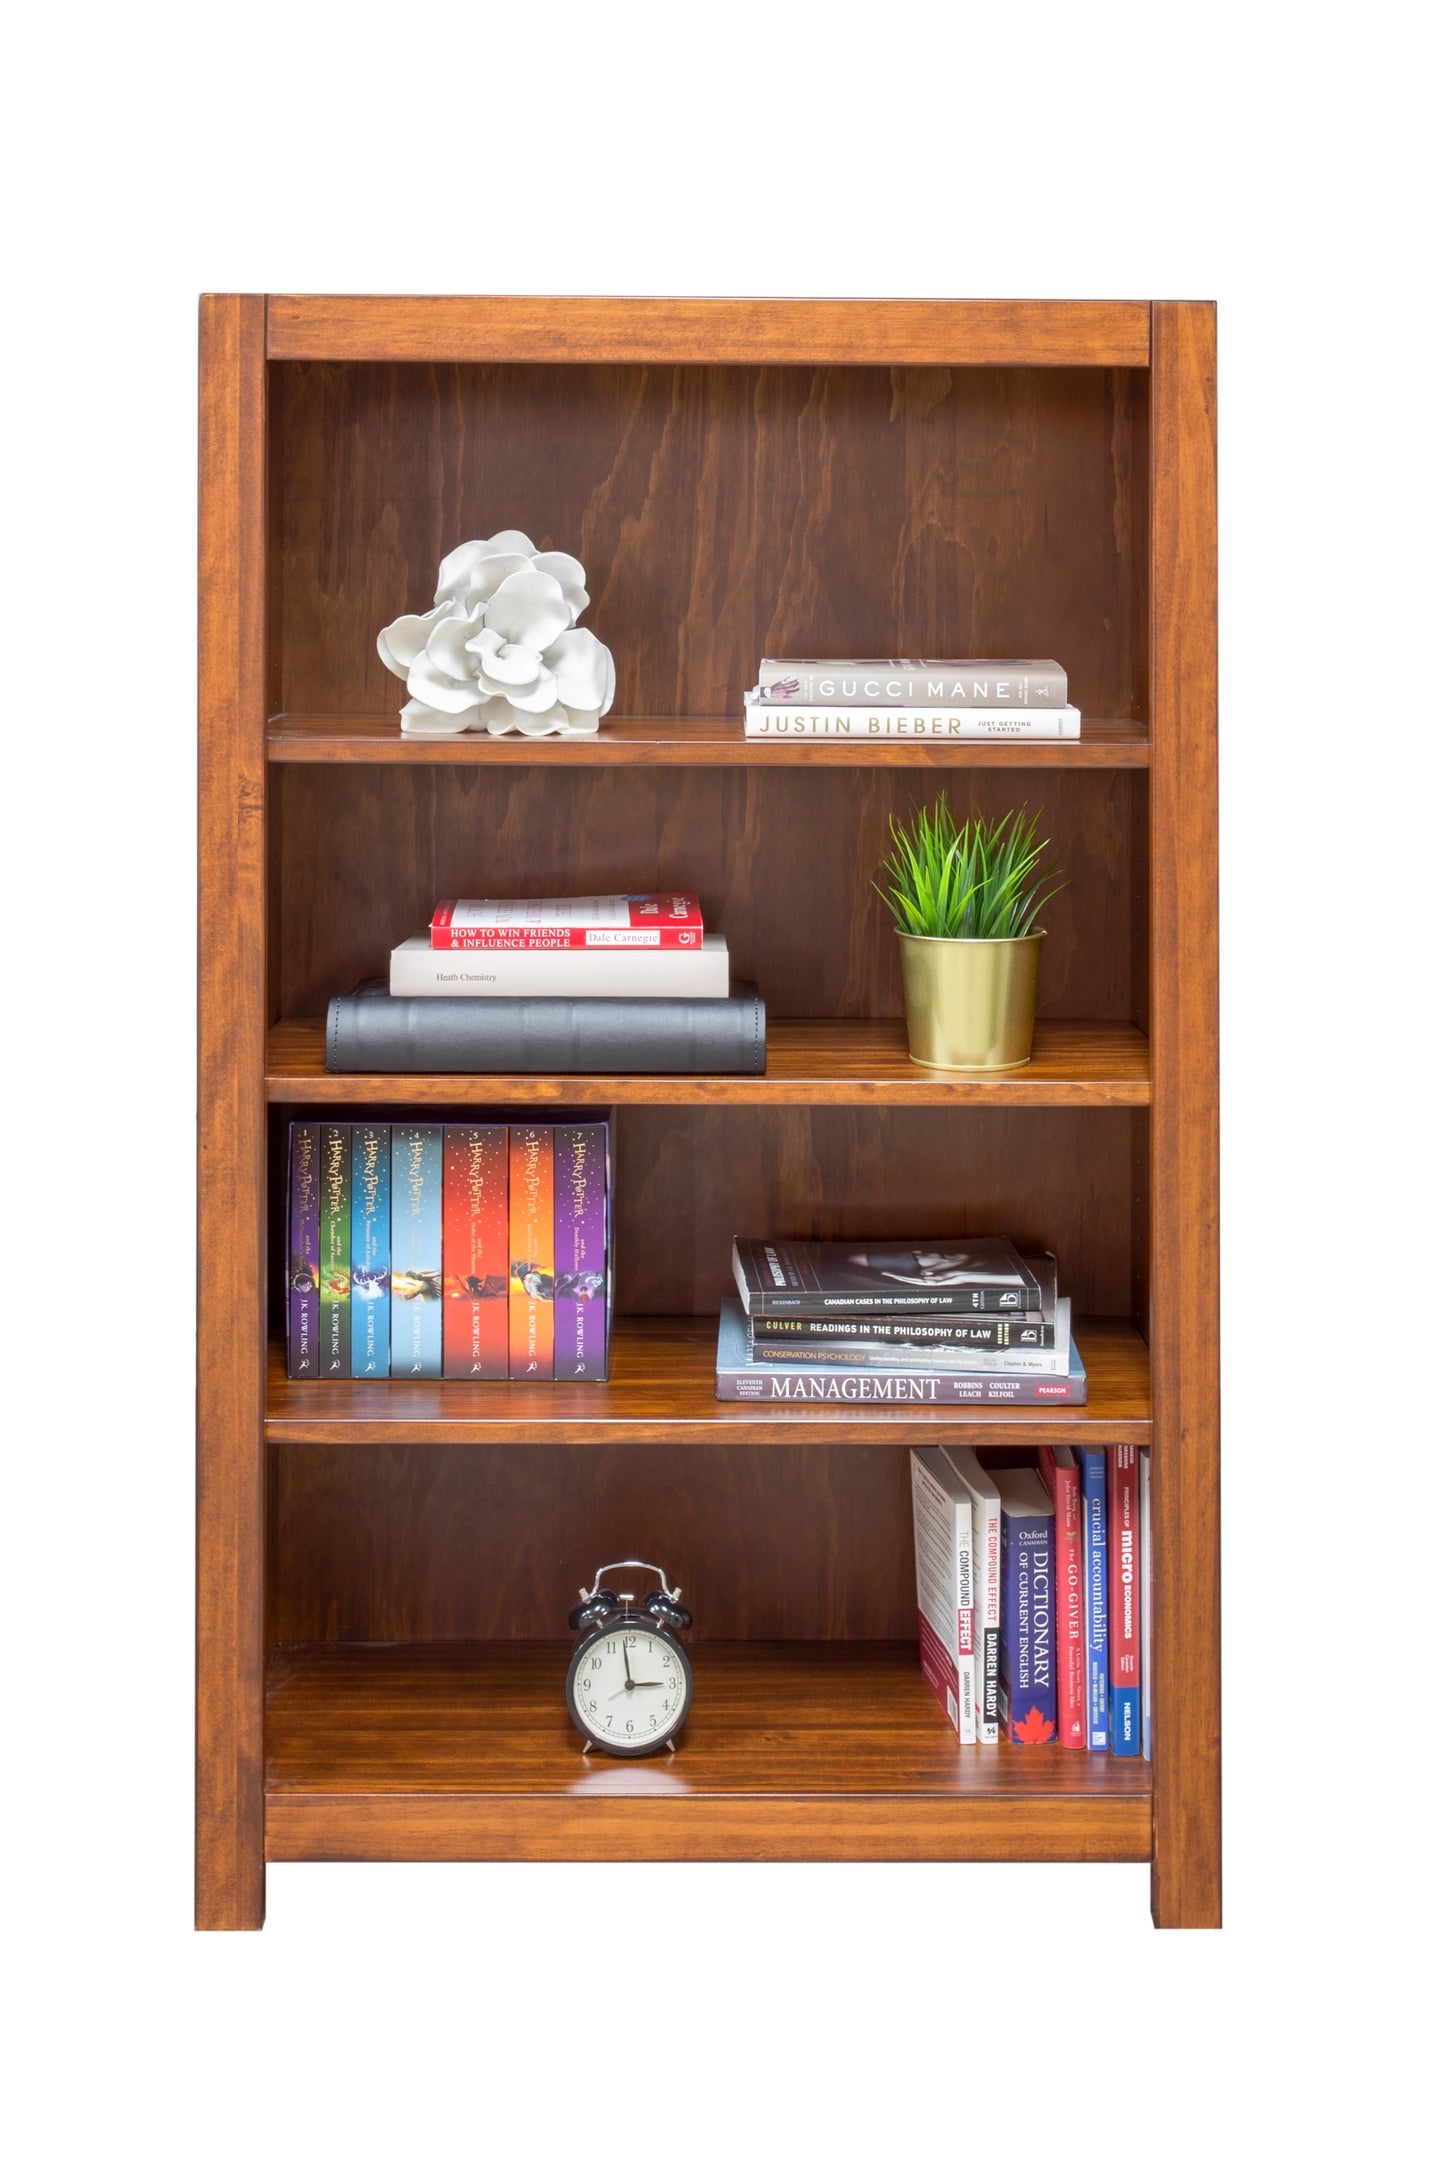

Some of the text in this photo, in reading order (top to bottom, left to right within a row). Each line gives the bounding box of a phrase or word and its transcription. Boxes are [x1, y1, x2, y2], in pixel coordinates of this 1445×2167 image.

[819, 680, 913, 698] GUCCI
[928, 681, 1010, 699] MANE
[760, 716, 961, 735] JUSTIN BIEBER
[451, 929, 571, 938] HOW TO WIN FRIENDS
[589, 933, 658, 944] Dale Carnegie
[678, 932, 691, 944] G
[451, 939, 571, 948] & INFLUENCE PEOPLE
[436, 973, 497, 983] Heath Chemistry
[303, 1129, 308, 1137] 1
[332, 1129, 339, 1137] 2
[368, 1131, 374, 1139] 3
[473, 1131, 479, 1139] 5
[529, 1131, 535, 1139] 6
[576, 1132, 583, 1140] 7
[766, 1320, 802, 1331] CULVER
[810, 1323, 991, 1339] READINGS IN THE PHILOSOPHY OF LAW
[300, 1312, 308, 1354] ROWLING
[331, 1313, 340, 1355] ROWLING
[366, 1315, 375, 1357] ROWLING
[472, 1315, 480, 1358] ROWLING
[528, 1315, 536, 1357] ROWLING
[576, 1316, 584, 1358] ROWLING
[763, 1350, 866, 1361] CONSERVATION PSYCHOLOGY
[1003, 1360, 1022, 1368] Clayton
[770, 1377, 941, 1400] MANAGEMENT
[989, 1382, 1021, 1390] COULTER
[1092, 1498, 1106, 1547] crucial
[1124, 1519, 1130, 1527] OF
[1019, 1530, 1048, 1540] Oxford
[1121, 1530, 1133, 1583] micro
[987, 1517, 997, 1622] THE COMPOUND EFFECT
[959, 1532, 972, 1650] THE COMPOUND EFFECT
[1067, 1564, 1079, 1639] GO-GIVER
[1089, 1551, 1107, 1652] accountability
[1124, 1585, 1132, 1639] ECONOMICS
[1019, 1552, 1029, 1688] OF CURRENT ENGLISH
[1033, 1551, 1050, 1688] DICTIONARY
[606, 1641, 617, 1654] 11
[625, 1636, 636, 1649] 12
[648, 1641, 652, 1653] 1
[591, 1657, 602, 1670] 10
[663, 1656, 670, 1668] 2
[986, 1633, 998, 1717] DARREN HARDY
[583, 1679, 591, 1691] 9
[669, 1677, 677, 1689] 3
[589, 1700, 597, 1713] 8
[662, 1699, 670, 1711] 4
[605, 1715, 613, 1728] 7
[626, 1720, 634, 1733] 6
[650, 1715, 657, 1727] 5
